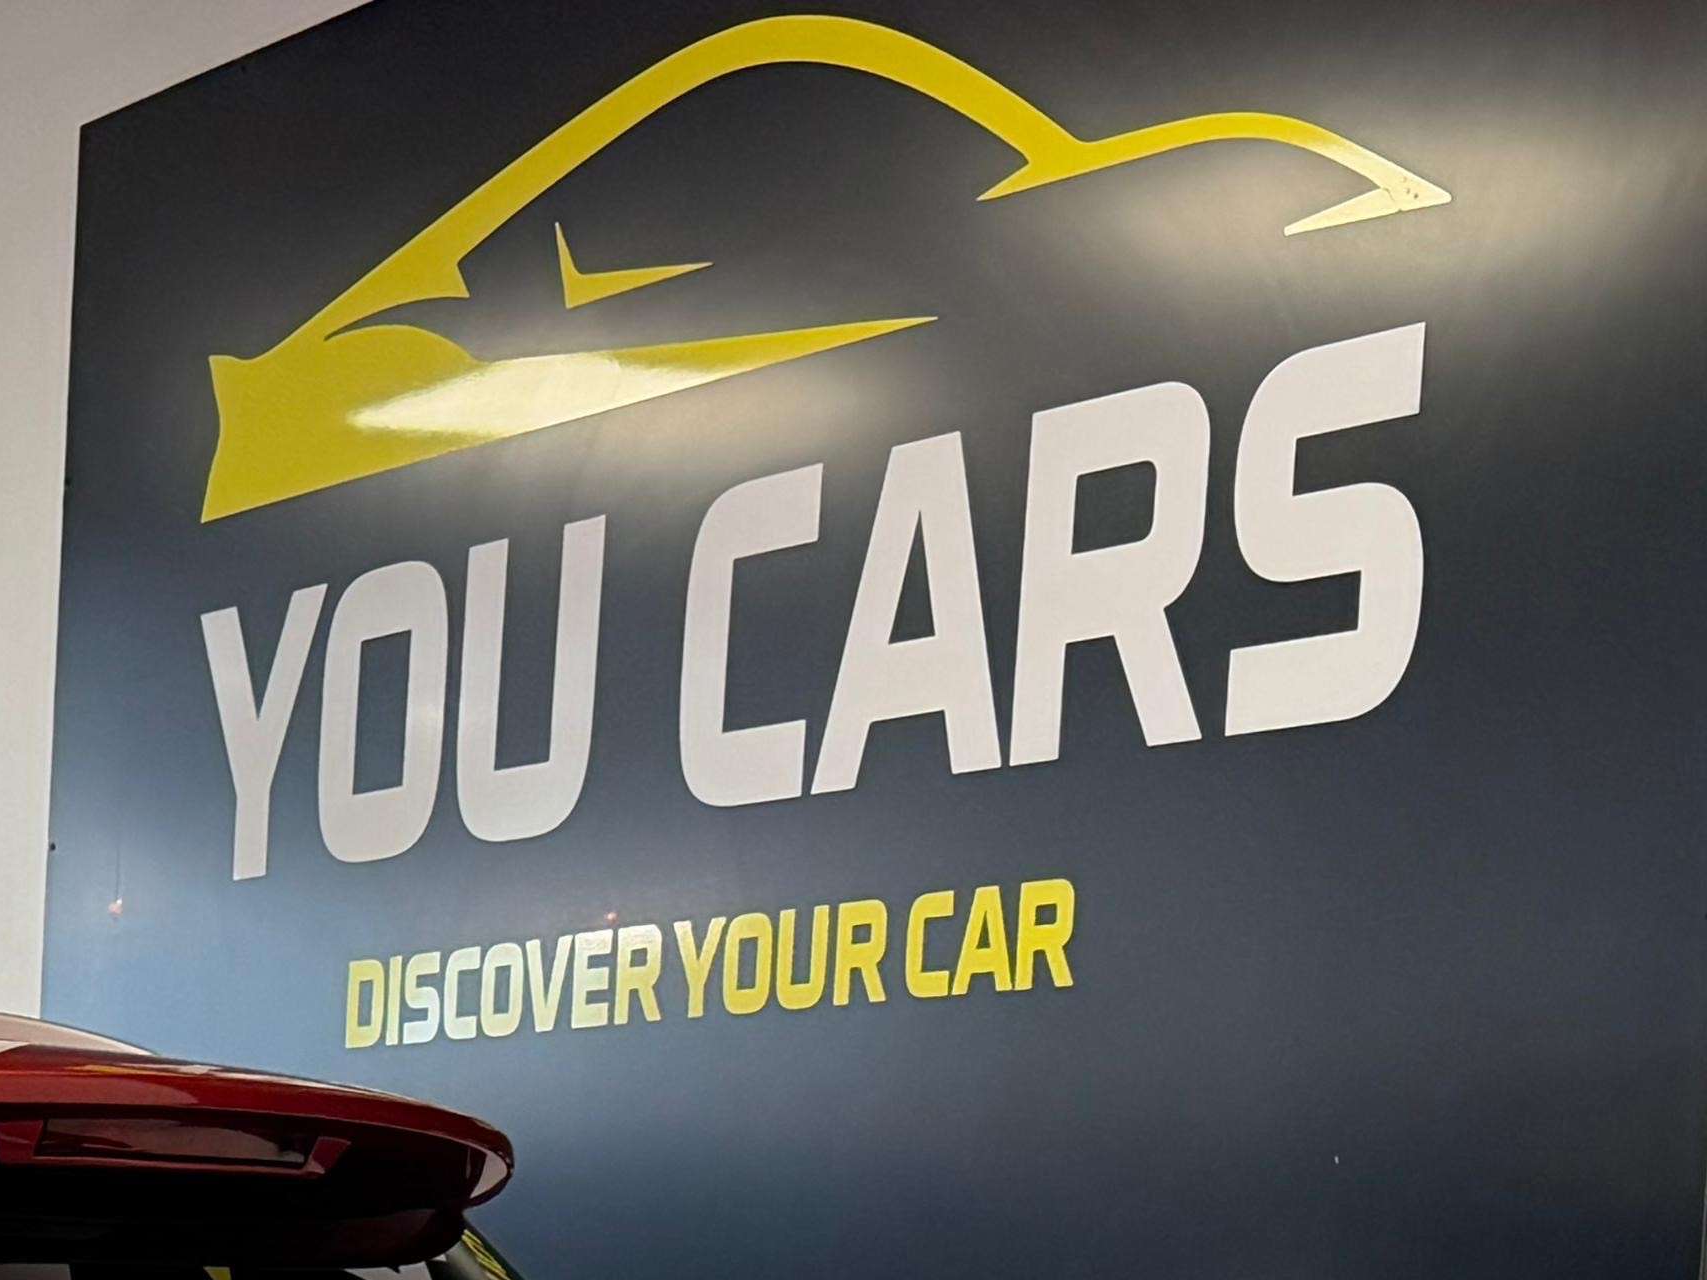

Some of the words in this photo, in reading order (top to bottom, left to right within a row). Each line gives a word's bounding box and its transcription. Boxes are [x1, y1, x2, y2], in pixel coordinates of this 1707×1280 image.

[199, 515, 605, 882] YOU
[679, 321, 1426, 809] CARS
[344, 923, 661, 1050] DISCOVER
[673, 899, 887, 1018] YOUR
[904, 878, 1074, 998] CAR
